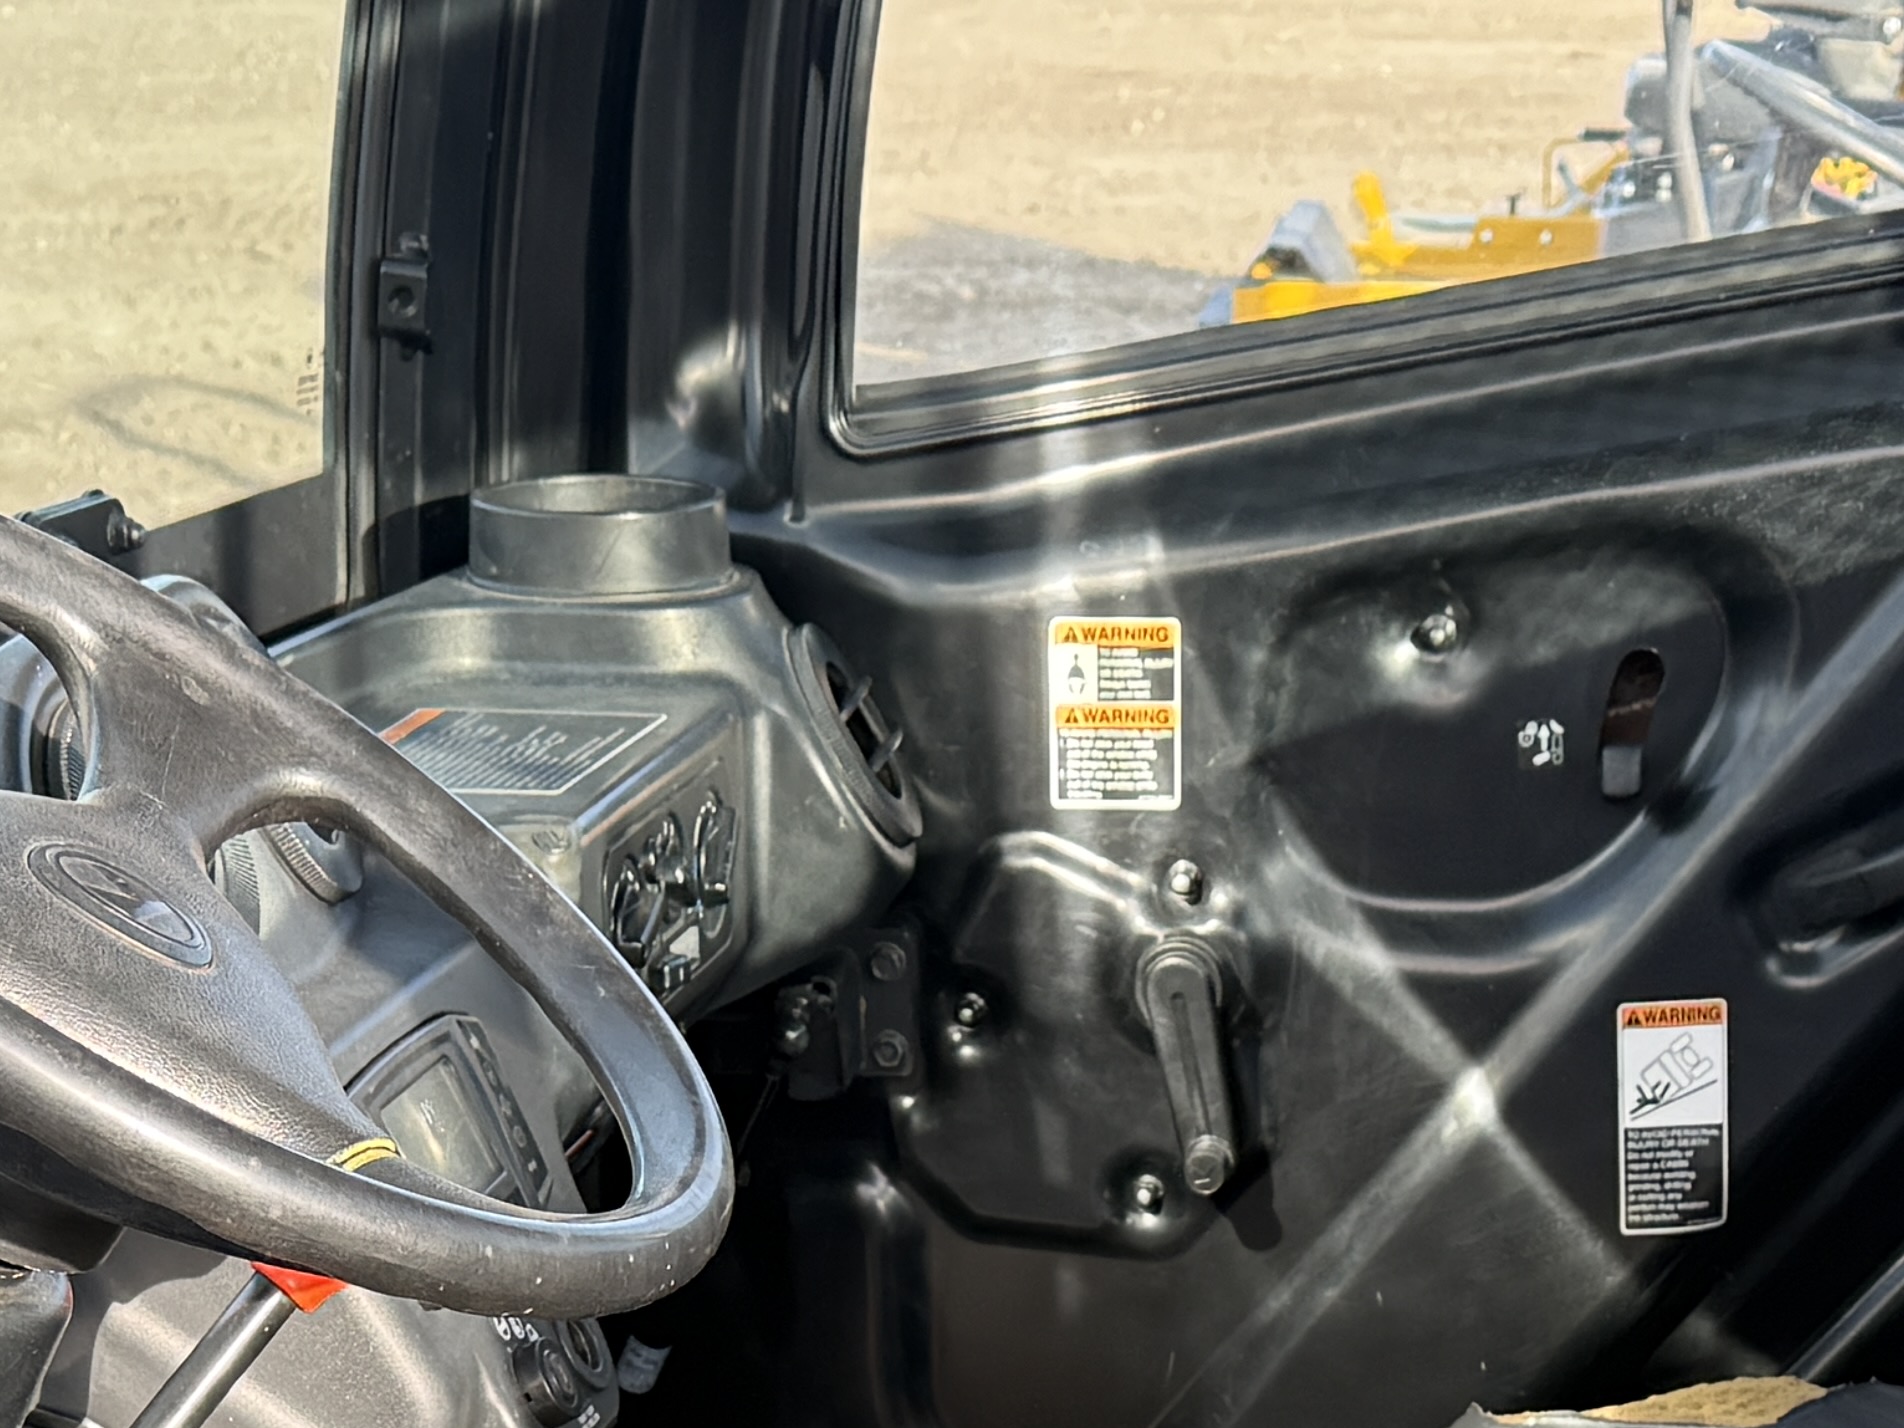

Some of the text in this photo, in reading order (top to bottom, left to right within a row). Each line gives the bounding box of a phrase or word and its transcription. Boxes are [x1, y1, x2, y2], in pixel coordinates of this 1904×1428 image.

[1081, 627, 1169, 642] WARNING
[1083, 709, 1169, 723] WARNING
[1644, 1005, 1721, 1024] WARNING
